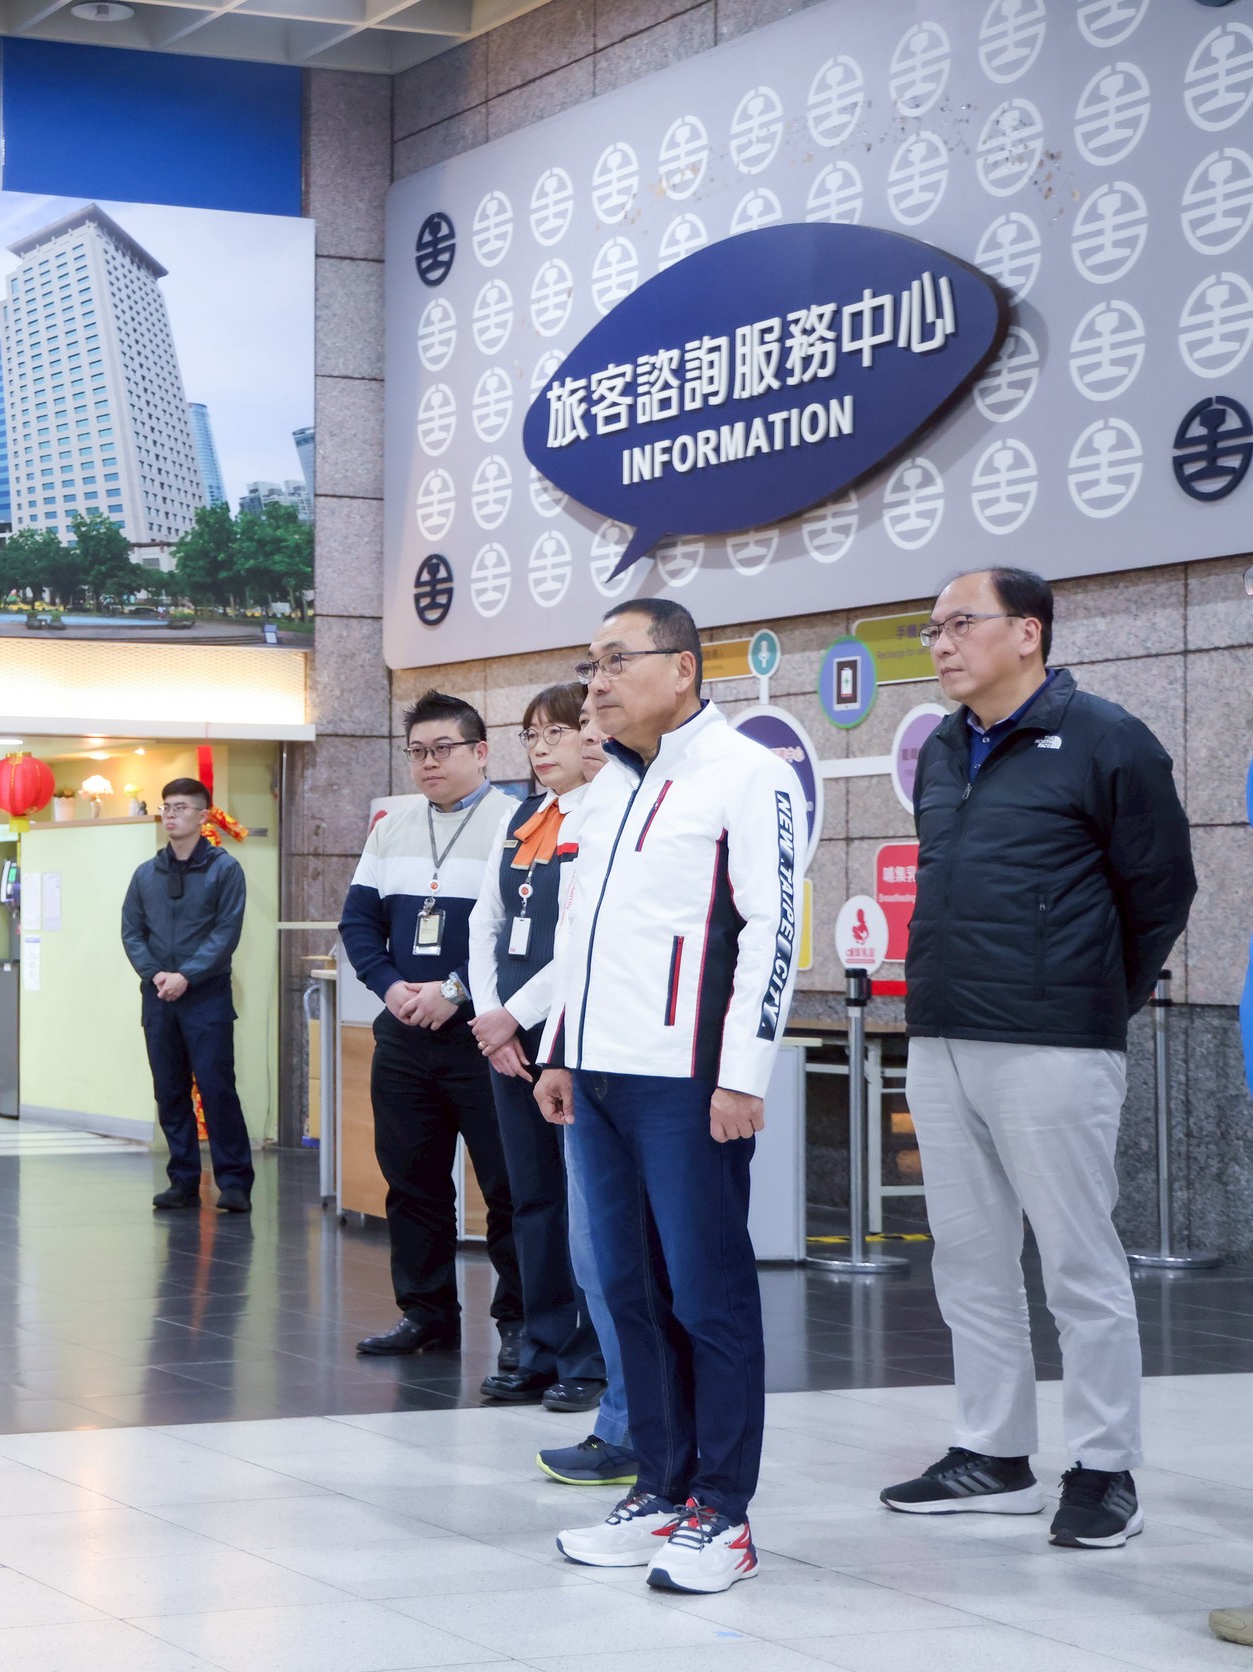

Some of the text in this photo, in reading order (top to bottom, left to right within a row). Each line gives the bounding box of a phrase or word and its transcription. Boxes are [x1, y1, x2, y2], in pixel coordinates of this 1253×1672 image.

[546, 271, 956, 448] 旅客諮詢服務中心
[622, 394, 854, 485] INFORMATION
[777, 794, 794, 856] NEW
